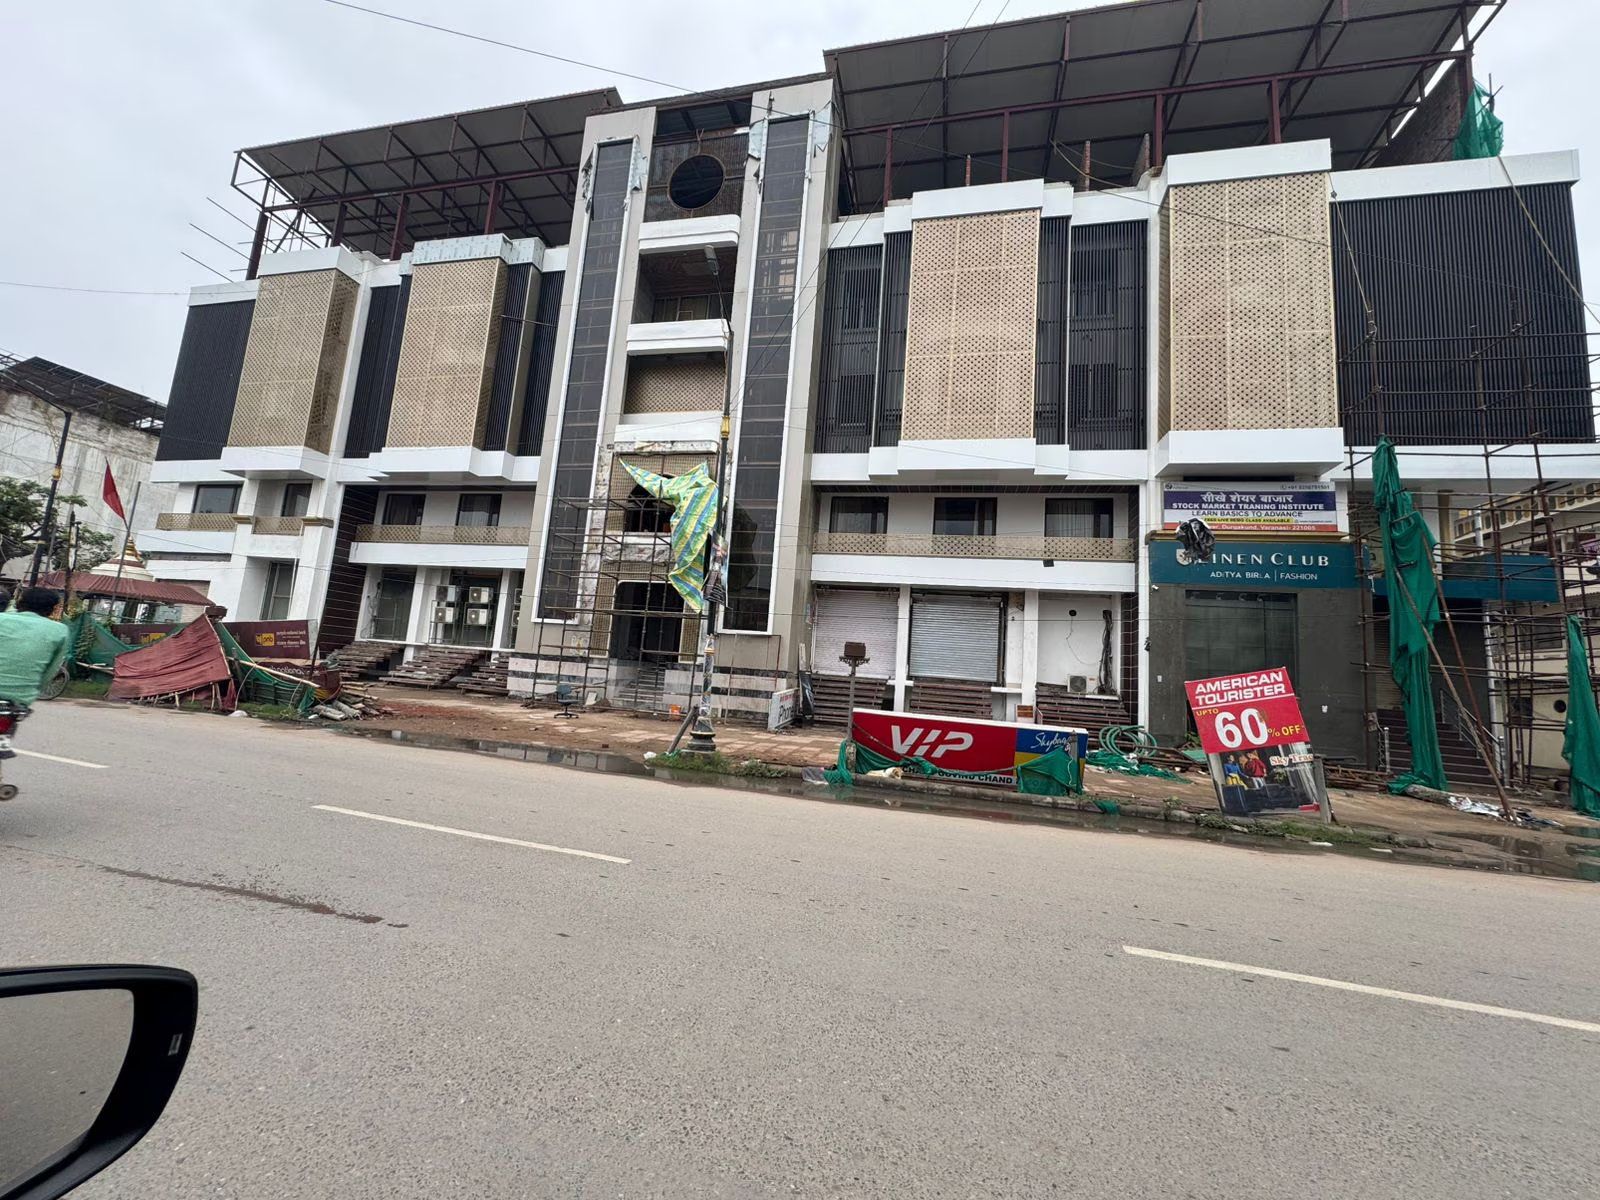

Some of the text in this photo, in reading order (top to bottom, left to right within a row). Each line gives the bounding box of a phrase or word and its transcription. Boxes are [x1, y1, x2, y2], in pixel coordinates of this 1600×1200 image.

[1200, 491, 1227, 503] सीखे
[1229, 491, 1257, 503] शेयर
[1270, 552, 1329, 566] CLUB
[1210, 571, 1242, 579] ADITYA
[1280, 572, 1318, 580] FASHION
[1195, 671, 1284, 695] AMERICAN
[1195, 682, 1286, 706] TOURISTER
[1196, 708, 1219, 717] UPTO
[891, 725, 974, 759] VIP
[1269, 755, 1289, 767] Sky
[977, 774, 1013, 785] CHAND
